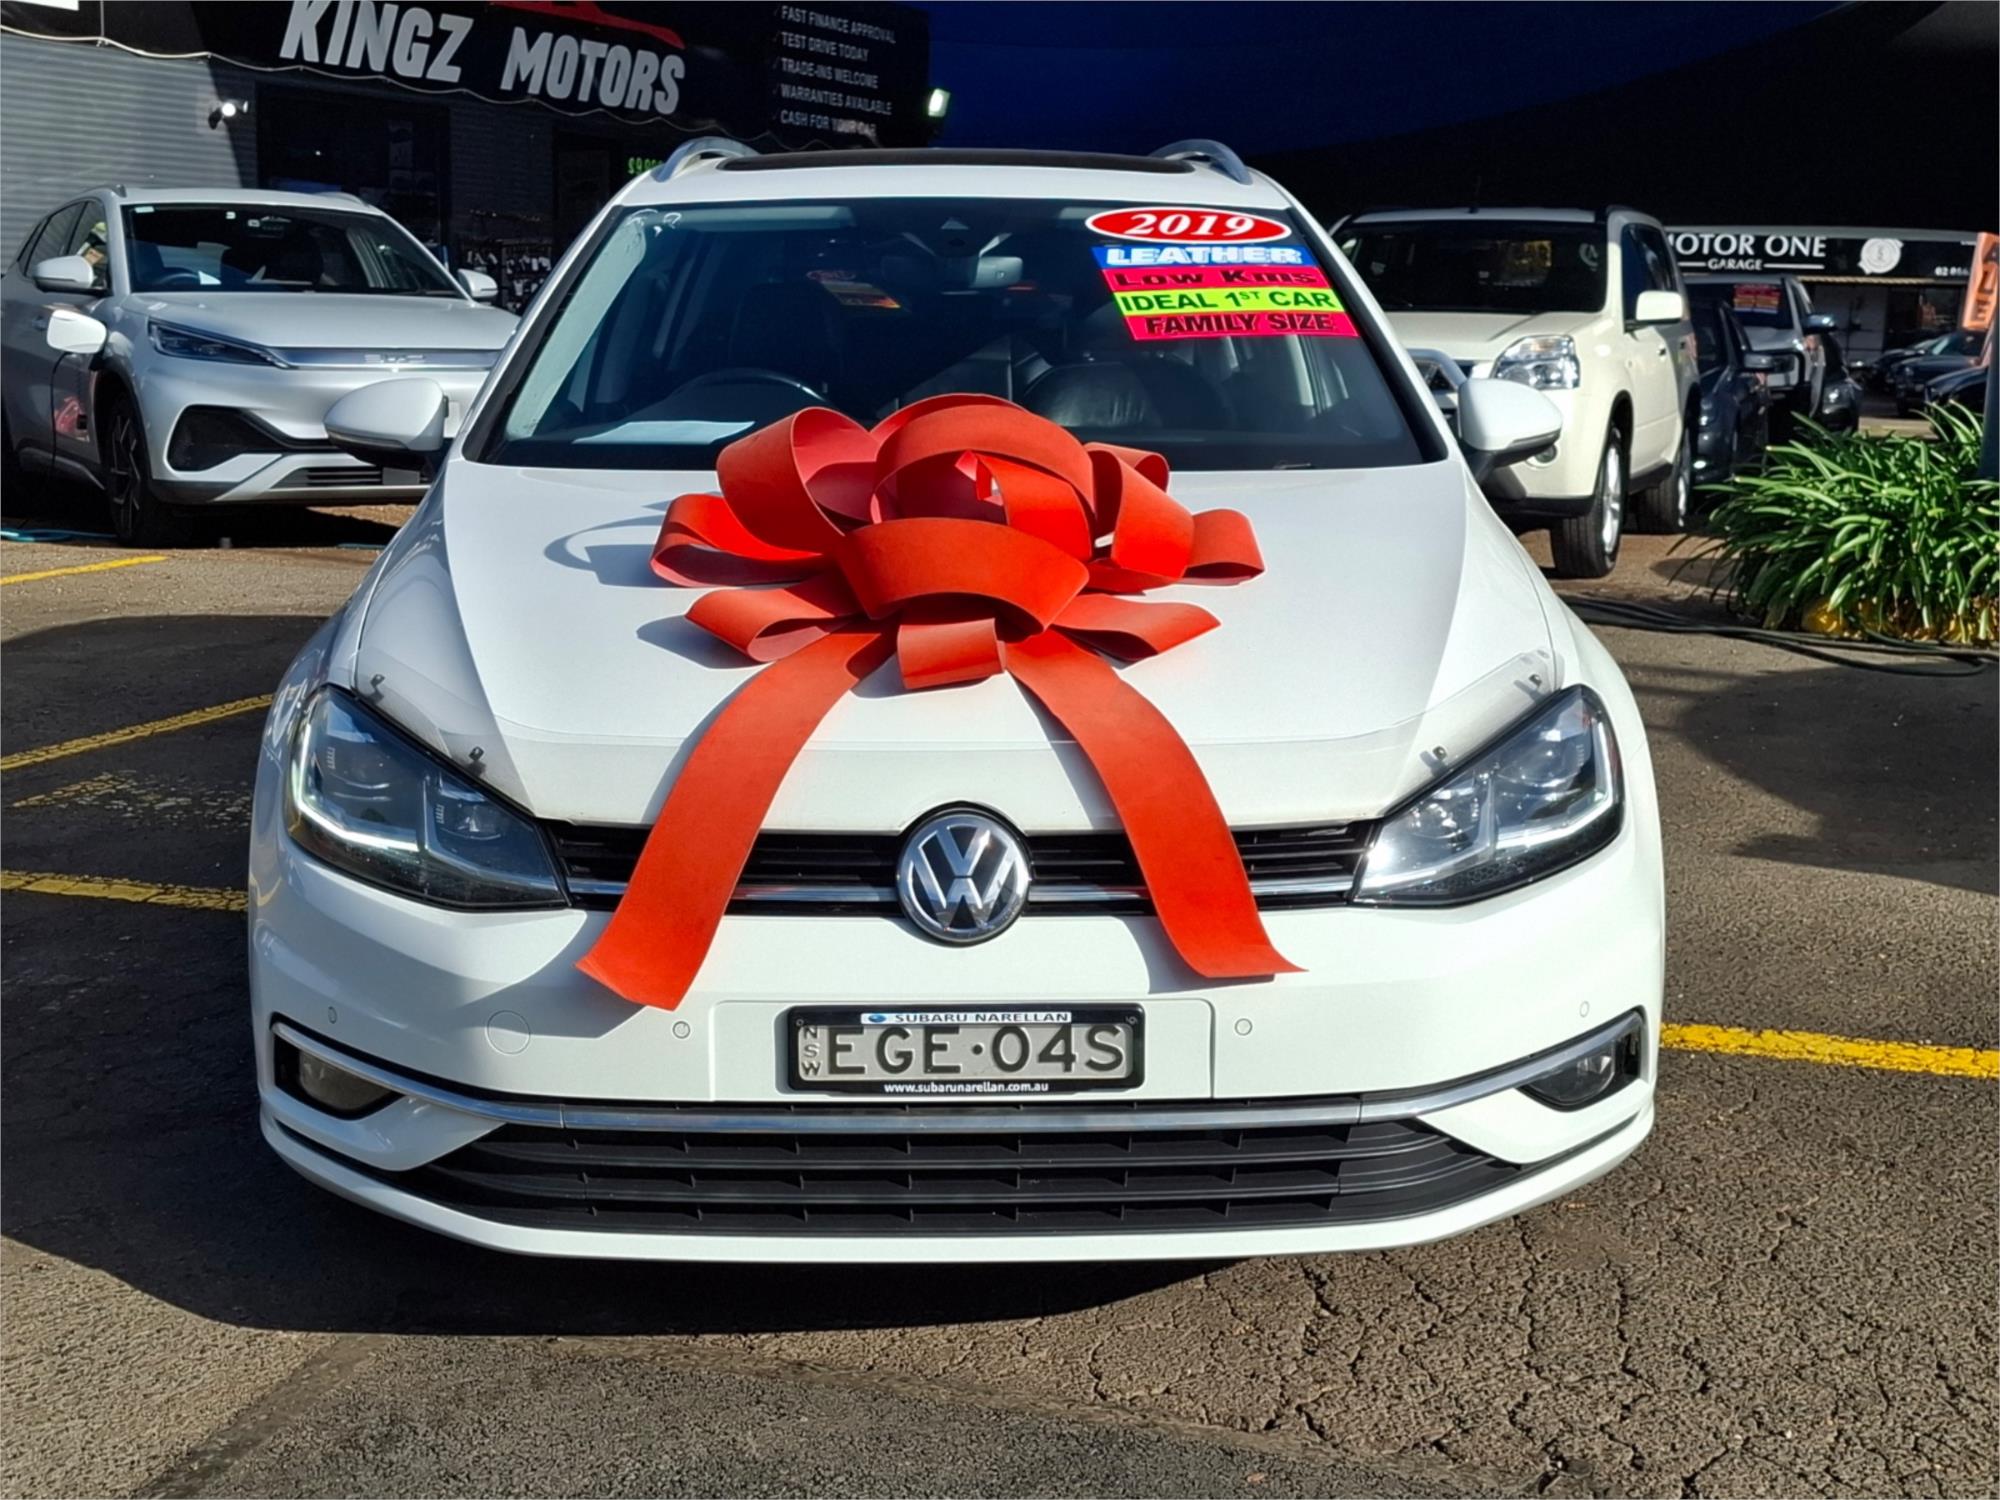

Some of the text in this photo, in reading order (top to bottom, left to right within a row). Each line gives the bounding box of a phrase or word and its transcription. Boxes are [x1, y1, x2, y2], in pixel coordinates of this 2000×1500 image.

[781, 5, 896, 44] FAST FINANCE APPROVAL
[781, 31, 870, 62] TEST DRIVE TODAY
[279, 1, 686, 115] KINGZ MOTORS
[780, 57, 879, 89] TRADE-INS WELCOME
[780, 83, 893, 115] WARRANTIES AVAILABLE
[779, 109, 808, 127] CASH
[809, 114, 830, 130] FOR
[1123, 213, 1255, 236] 2019
[1106, 246, 1302, 265] LEATHER
[1764, 235, 1827, 257] ONE
[1707, 258, 1763, 271] GARAGE
[1220, 270, 1318, 284] Kms
[1120, 293, 1219, 312] IDEAL
[1267, 291, 1338, 308] CAR
[1147, 312, 1333, 334] FAMILY SIZE
[894, 1012, 1069, 1024] SUBARU NARELLAN
[884, 1080, 1049, 1093] www.subarunarellan.com.au
